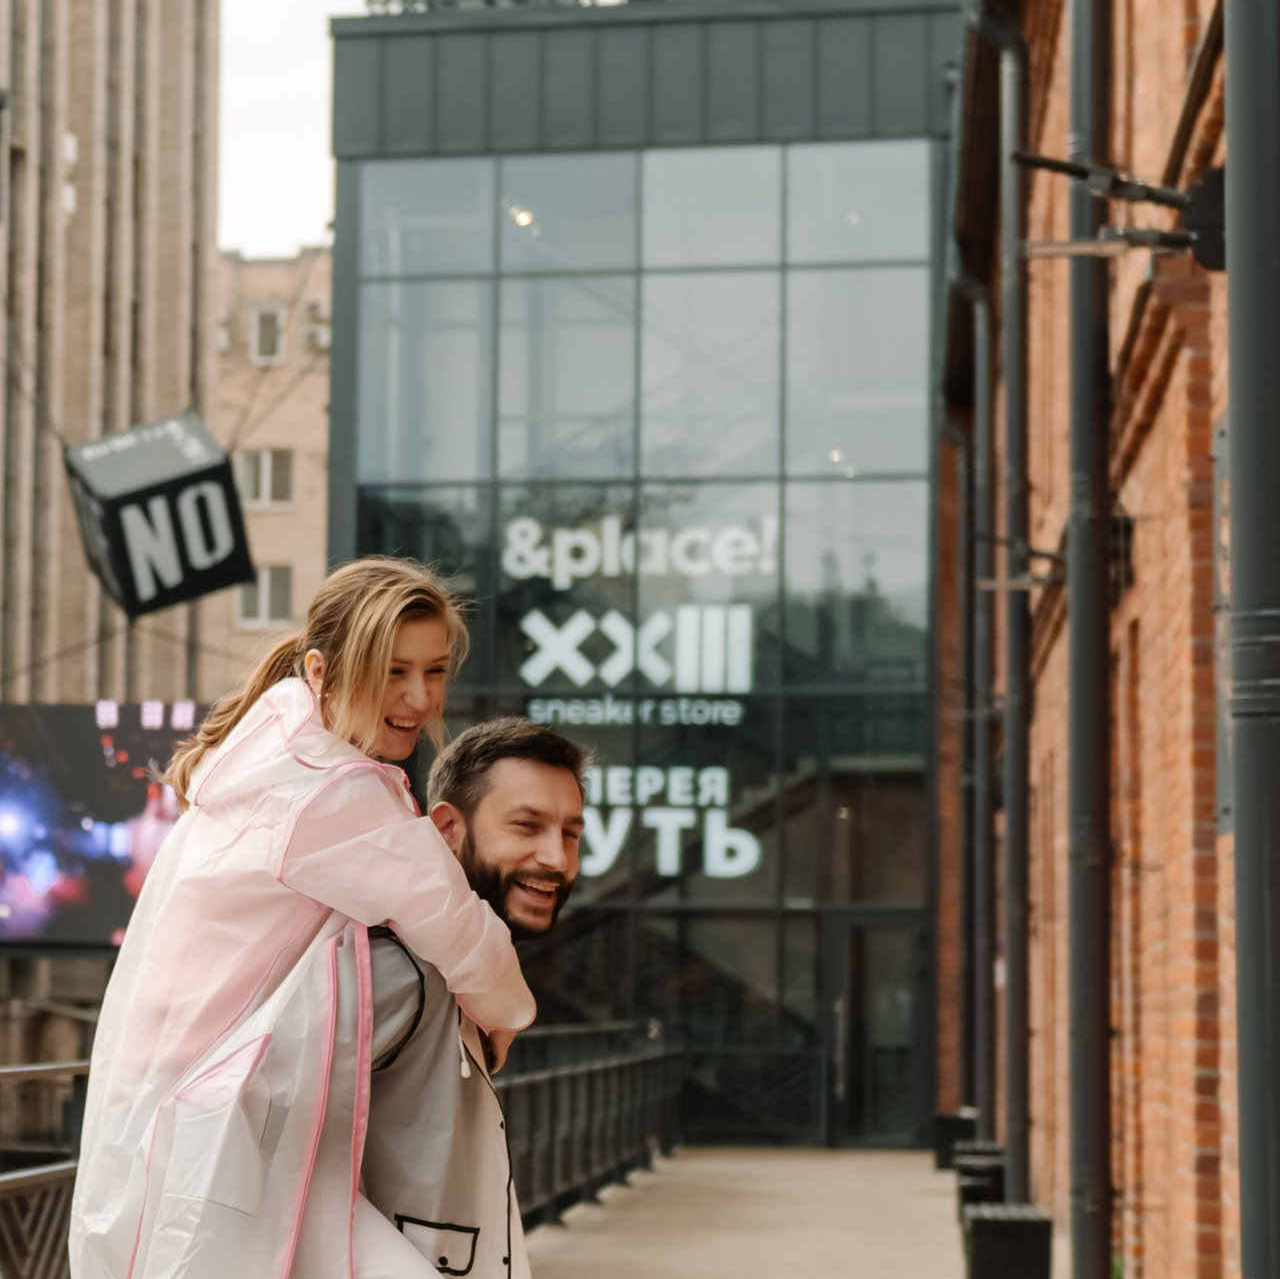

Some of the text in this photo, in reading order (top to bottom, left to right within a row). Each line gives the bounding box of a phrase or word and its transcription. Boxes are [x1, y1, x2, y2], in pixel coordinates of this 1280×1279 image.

[119, 480, 235, 604] NO
[501, 514, 779, 590] &place!
[659, 697, 743, 726] store
